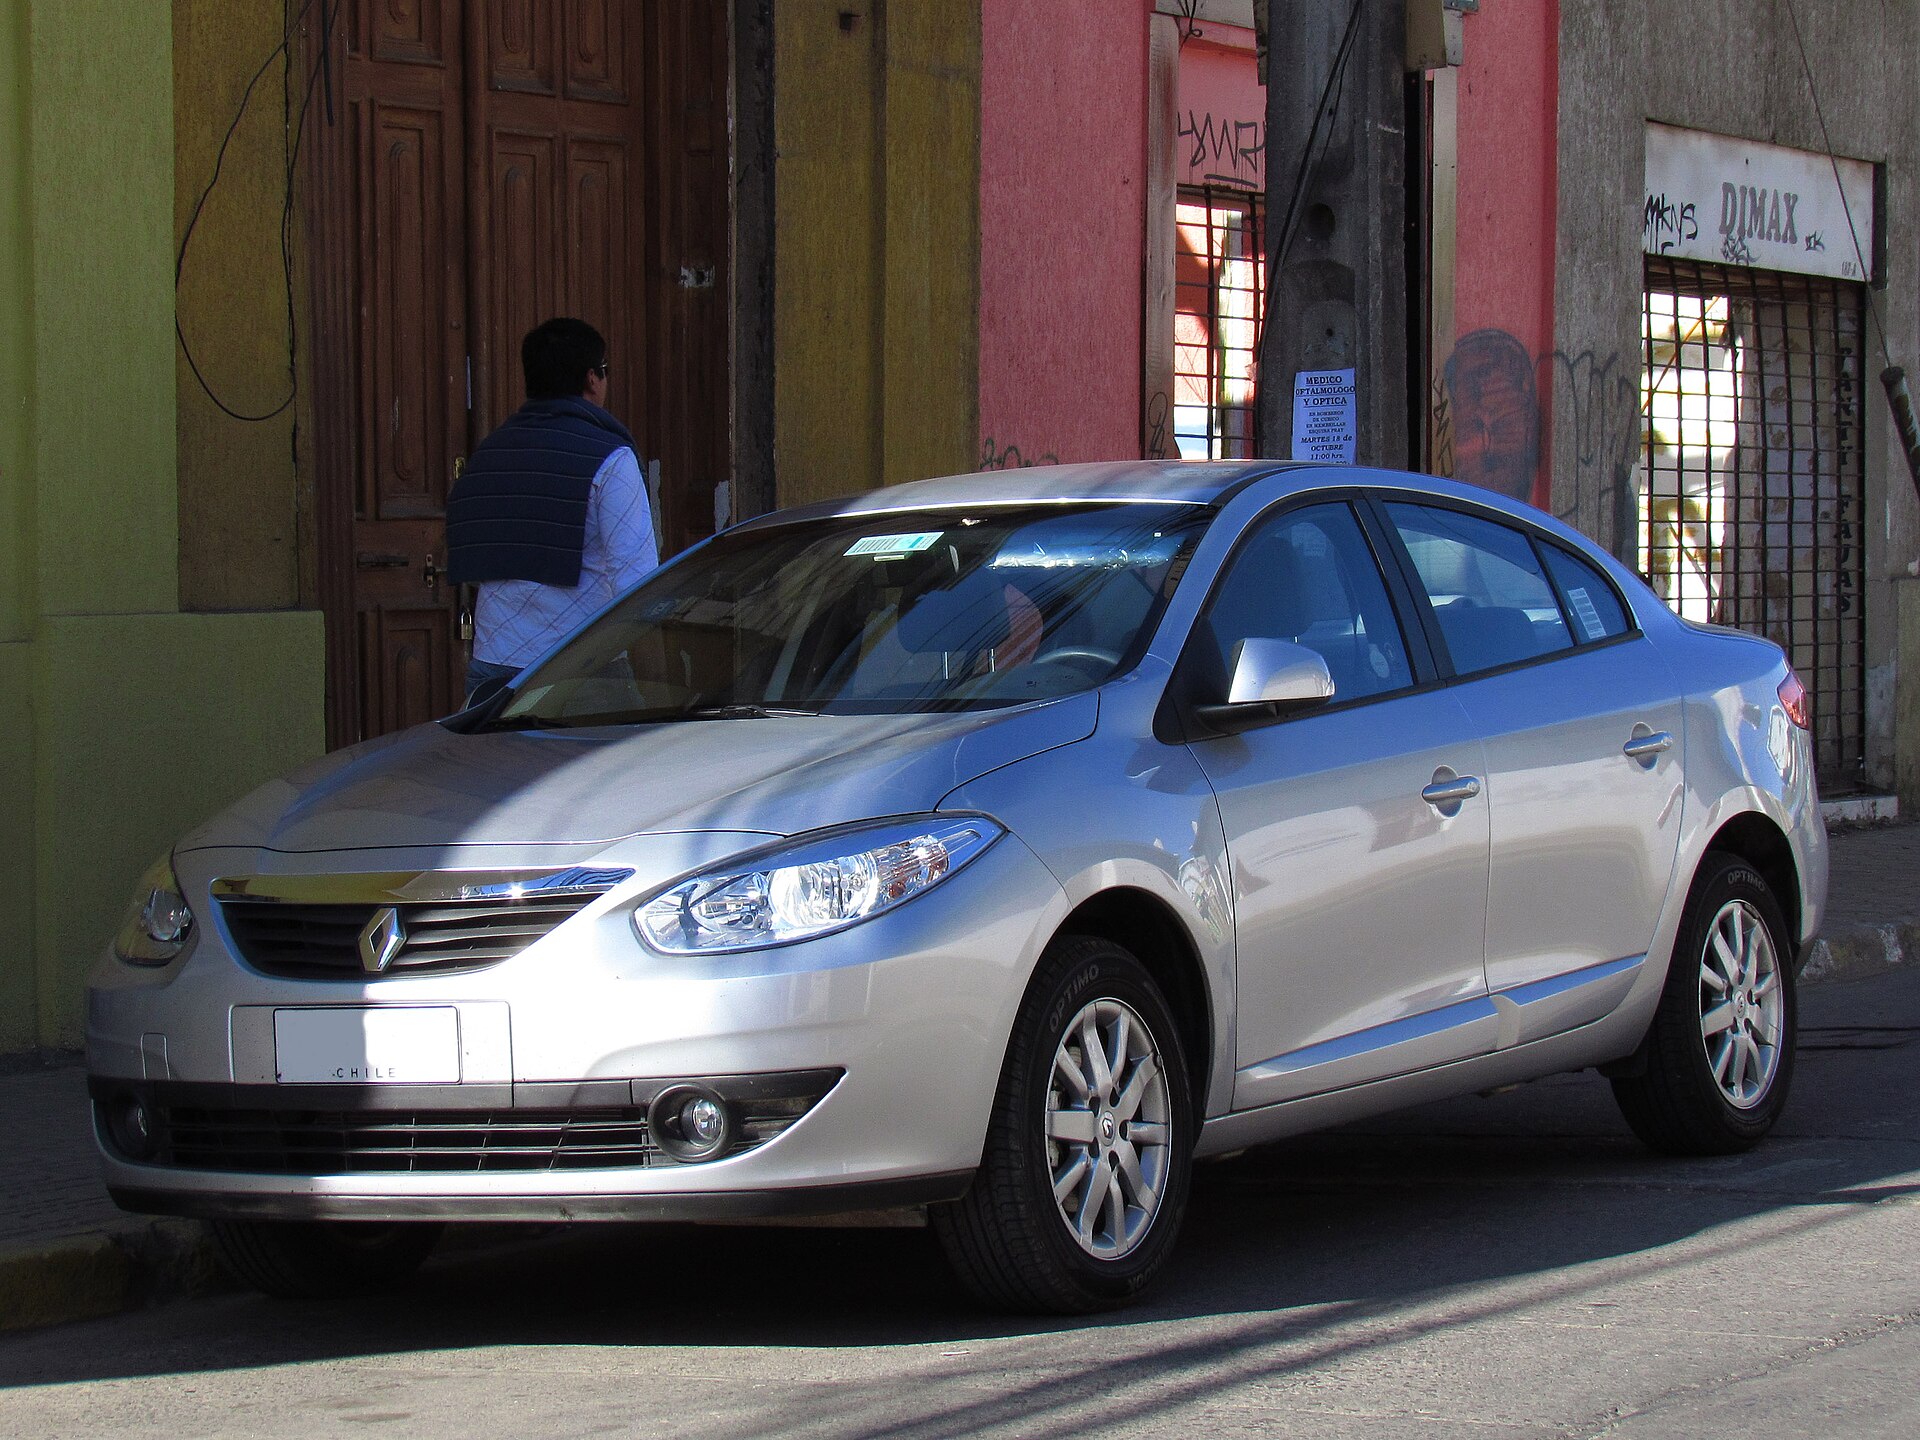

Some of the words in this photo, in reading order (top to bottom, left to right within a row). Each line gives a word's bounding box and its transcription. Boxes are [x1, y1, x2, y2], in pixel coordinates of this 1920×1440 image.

[1718, 182, 1798, 244] DIMAX
[1306, 376, 1342, 385] MEDICO
[1296, 386, 1355, 395] OFTALMOLOGO
[1312, 397, 1347, 405] OPTICA
[1311, 444, 1344, 452] OCTUBRE
[1727, 869, 1766, 892] OPTIMO
[1049, 963, 1100, 1034] OPTIMO
[336, 1067, 396, 1079] CHILE
